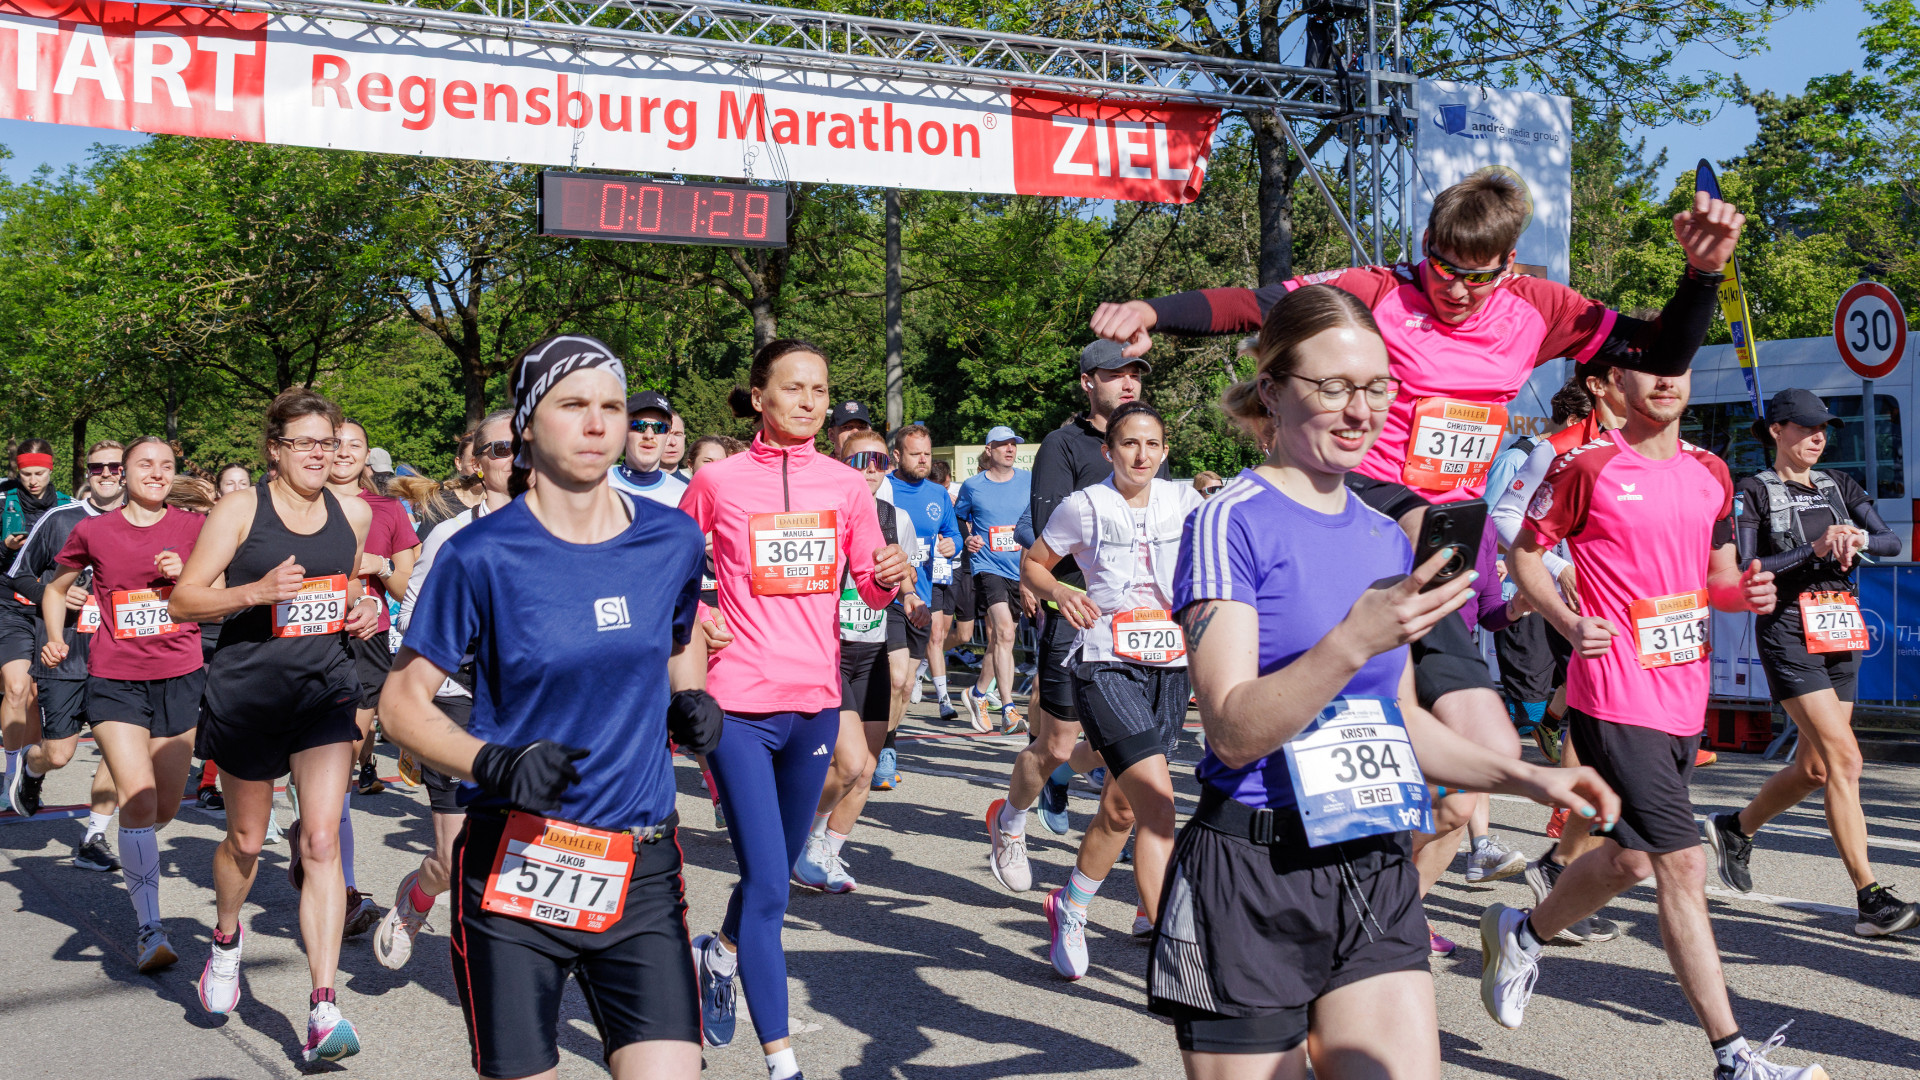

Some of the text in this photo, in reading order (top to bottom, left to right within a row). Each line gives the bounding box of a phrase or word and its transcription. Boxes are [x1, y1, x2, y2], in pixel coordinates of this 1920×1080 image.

[312, 54, 698, 152] Regensburg
[1472, 122, 1559, 143] andré media group
[1052, 114, 1192, 181] ZIEL
[600, 183, 769, 239] 0:01:28
[1850, 309, 1891, 352] 30
[1449, 407, 1486, 419] DAHLER
[1446, 421, 1482, 433] CHRISTOPH
[1429, 431, 1486, 459] 3141
[782, 530, 814, 538] MANUELA
[768, 540, 826, 563] 3647
[302, 581, 328, 590] AHLER
[806, 579, 829, 590] 3647
[287, 601, 338, 623] 2329
[1660, 598, 1693, 611] DAHLER
[124, 608, 169, 626] 4378
[1664, 612, 1693, 624] JOHANNES
[1816, 612, 1854, 630] 2747
[1127, 630, 1175, 650] 6720
[1653, 620, 1705, 650] 3143
[1847, 640, 1864, 649] 2747
[1340, 727, 1377, 740] KRISTIN
[1331, 744, 1401, 783] 384
[550, 831, 602, 852] DAHLER
[556, 853, 586, 868] JAKOB
[516, 860, 609, 907] 5717
